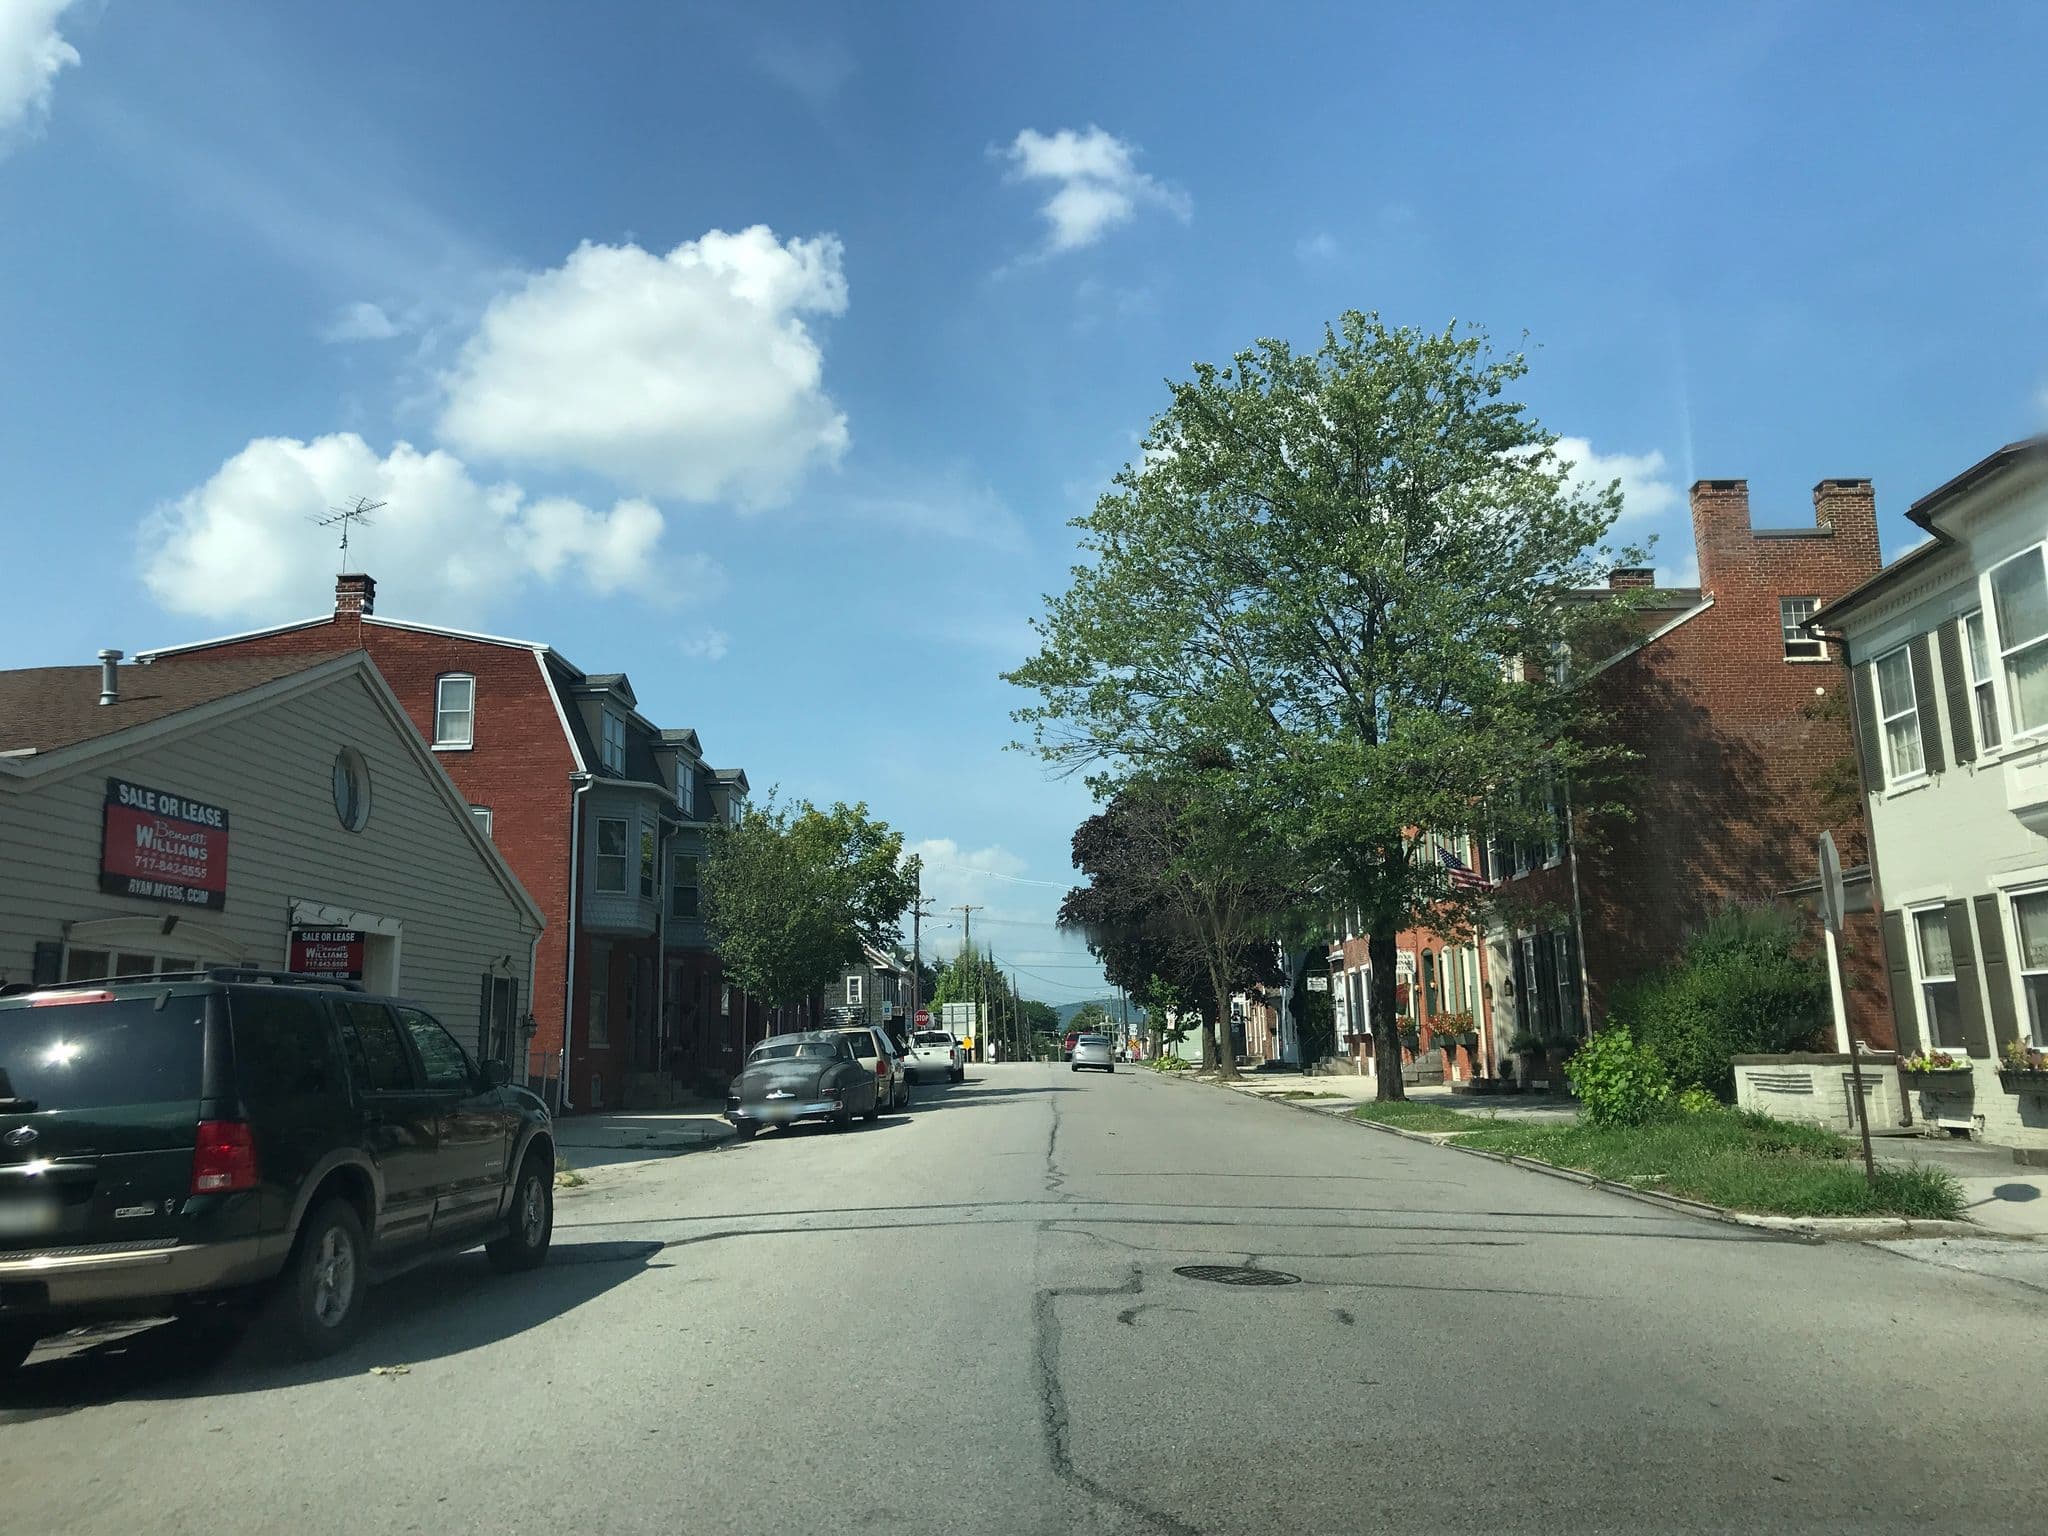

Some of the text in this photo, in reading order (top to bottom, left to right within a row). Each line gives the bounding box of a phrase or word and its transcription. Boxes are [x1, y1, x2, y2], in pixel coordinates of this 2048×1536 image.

[119, 784, 222, 827] SALE OR LEASE
[136, 824, 208, 860] WILLIAMS
[134, 855, 207, 879] 717-843-5555
[128, 879, 209, 904] RYAN MYERS, CCIM
[302, 932, 355, 941] SALE OR LEASE
[306, 947, 349, 959] WILLIAMS
